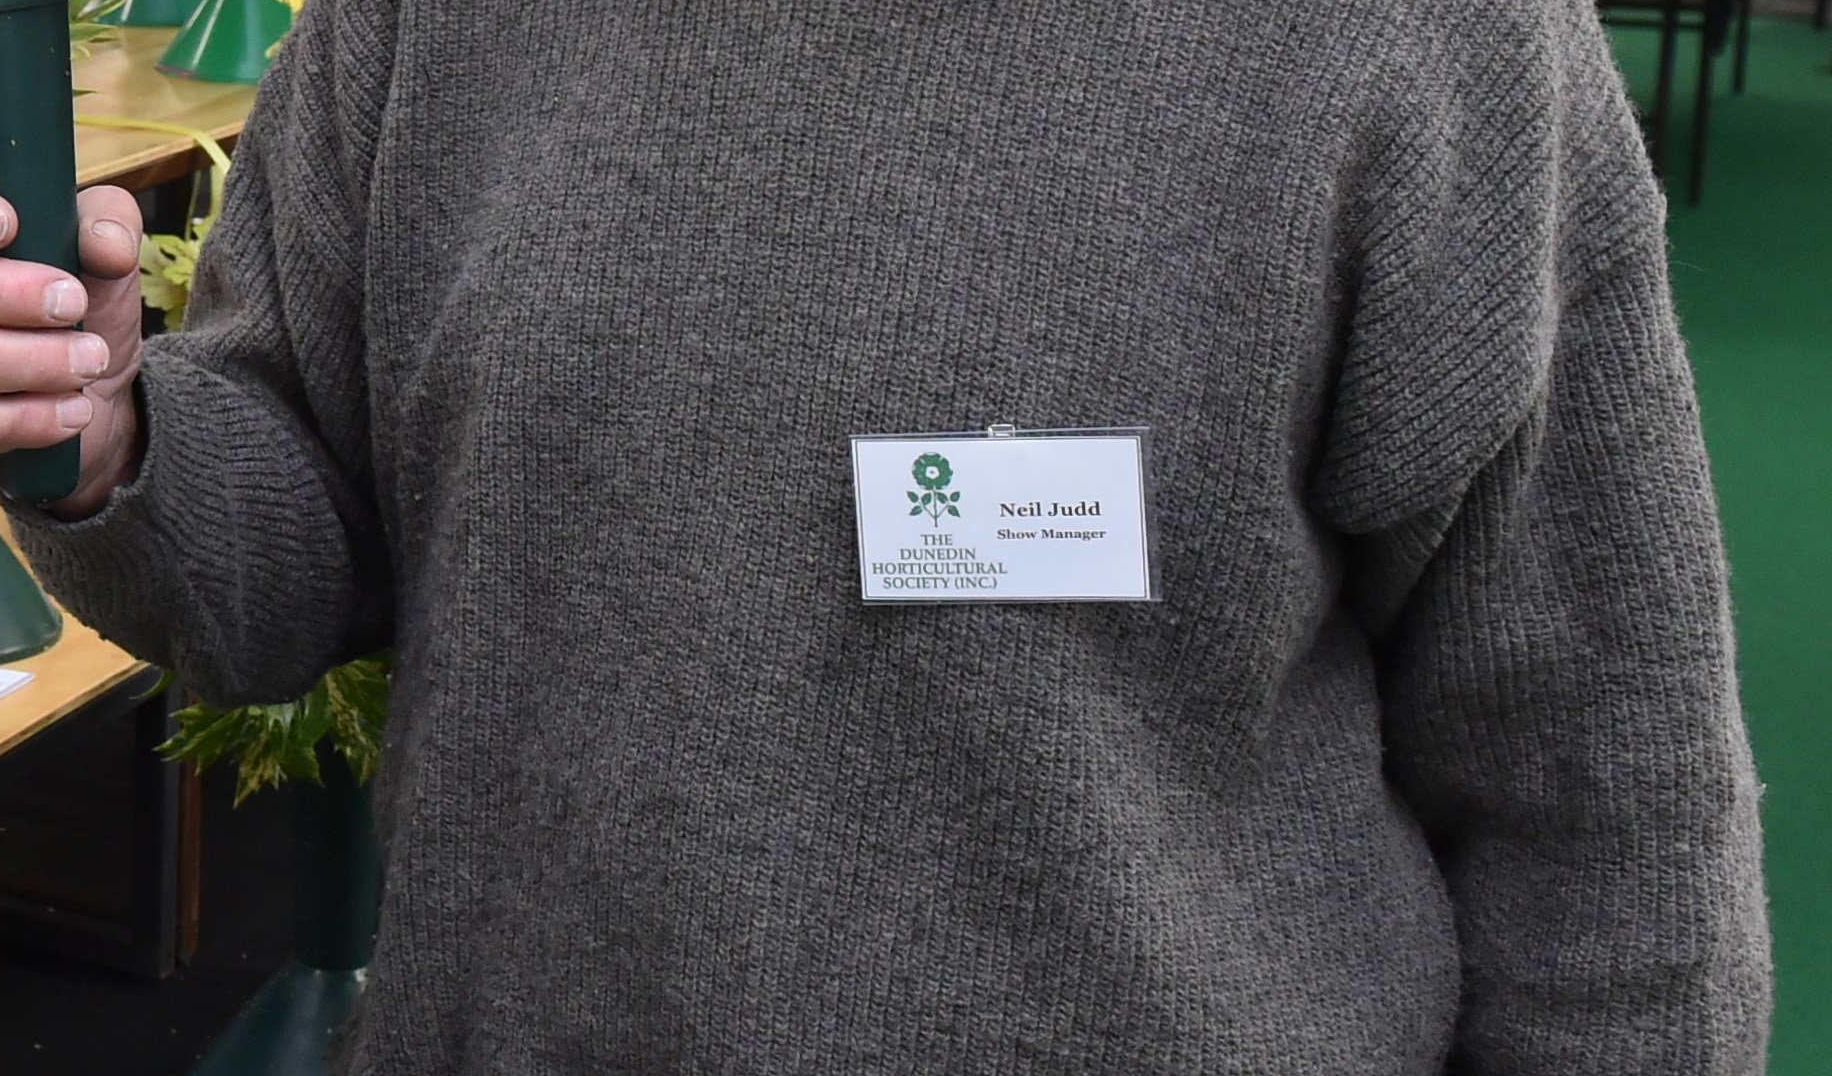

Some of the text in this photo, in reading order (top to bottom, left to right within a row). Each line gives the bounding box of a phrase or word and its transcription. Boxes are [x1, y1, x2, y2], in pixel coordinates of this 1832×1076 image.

[999, 501, 1101, 517] Neil Judd
[920, 533, 953, 546] THE
[996, 528, 1107, 541] Show Manager
[899, 547, 976, 561] DUNEDIN
[871, 561, 1008, 575] HORTICULTURAL
[882, 576, 998, 589] SOCIETY (INC.)
